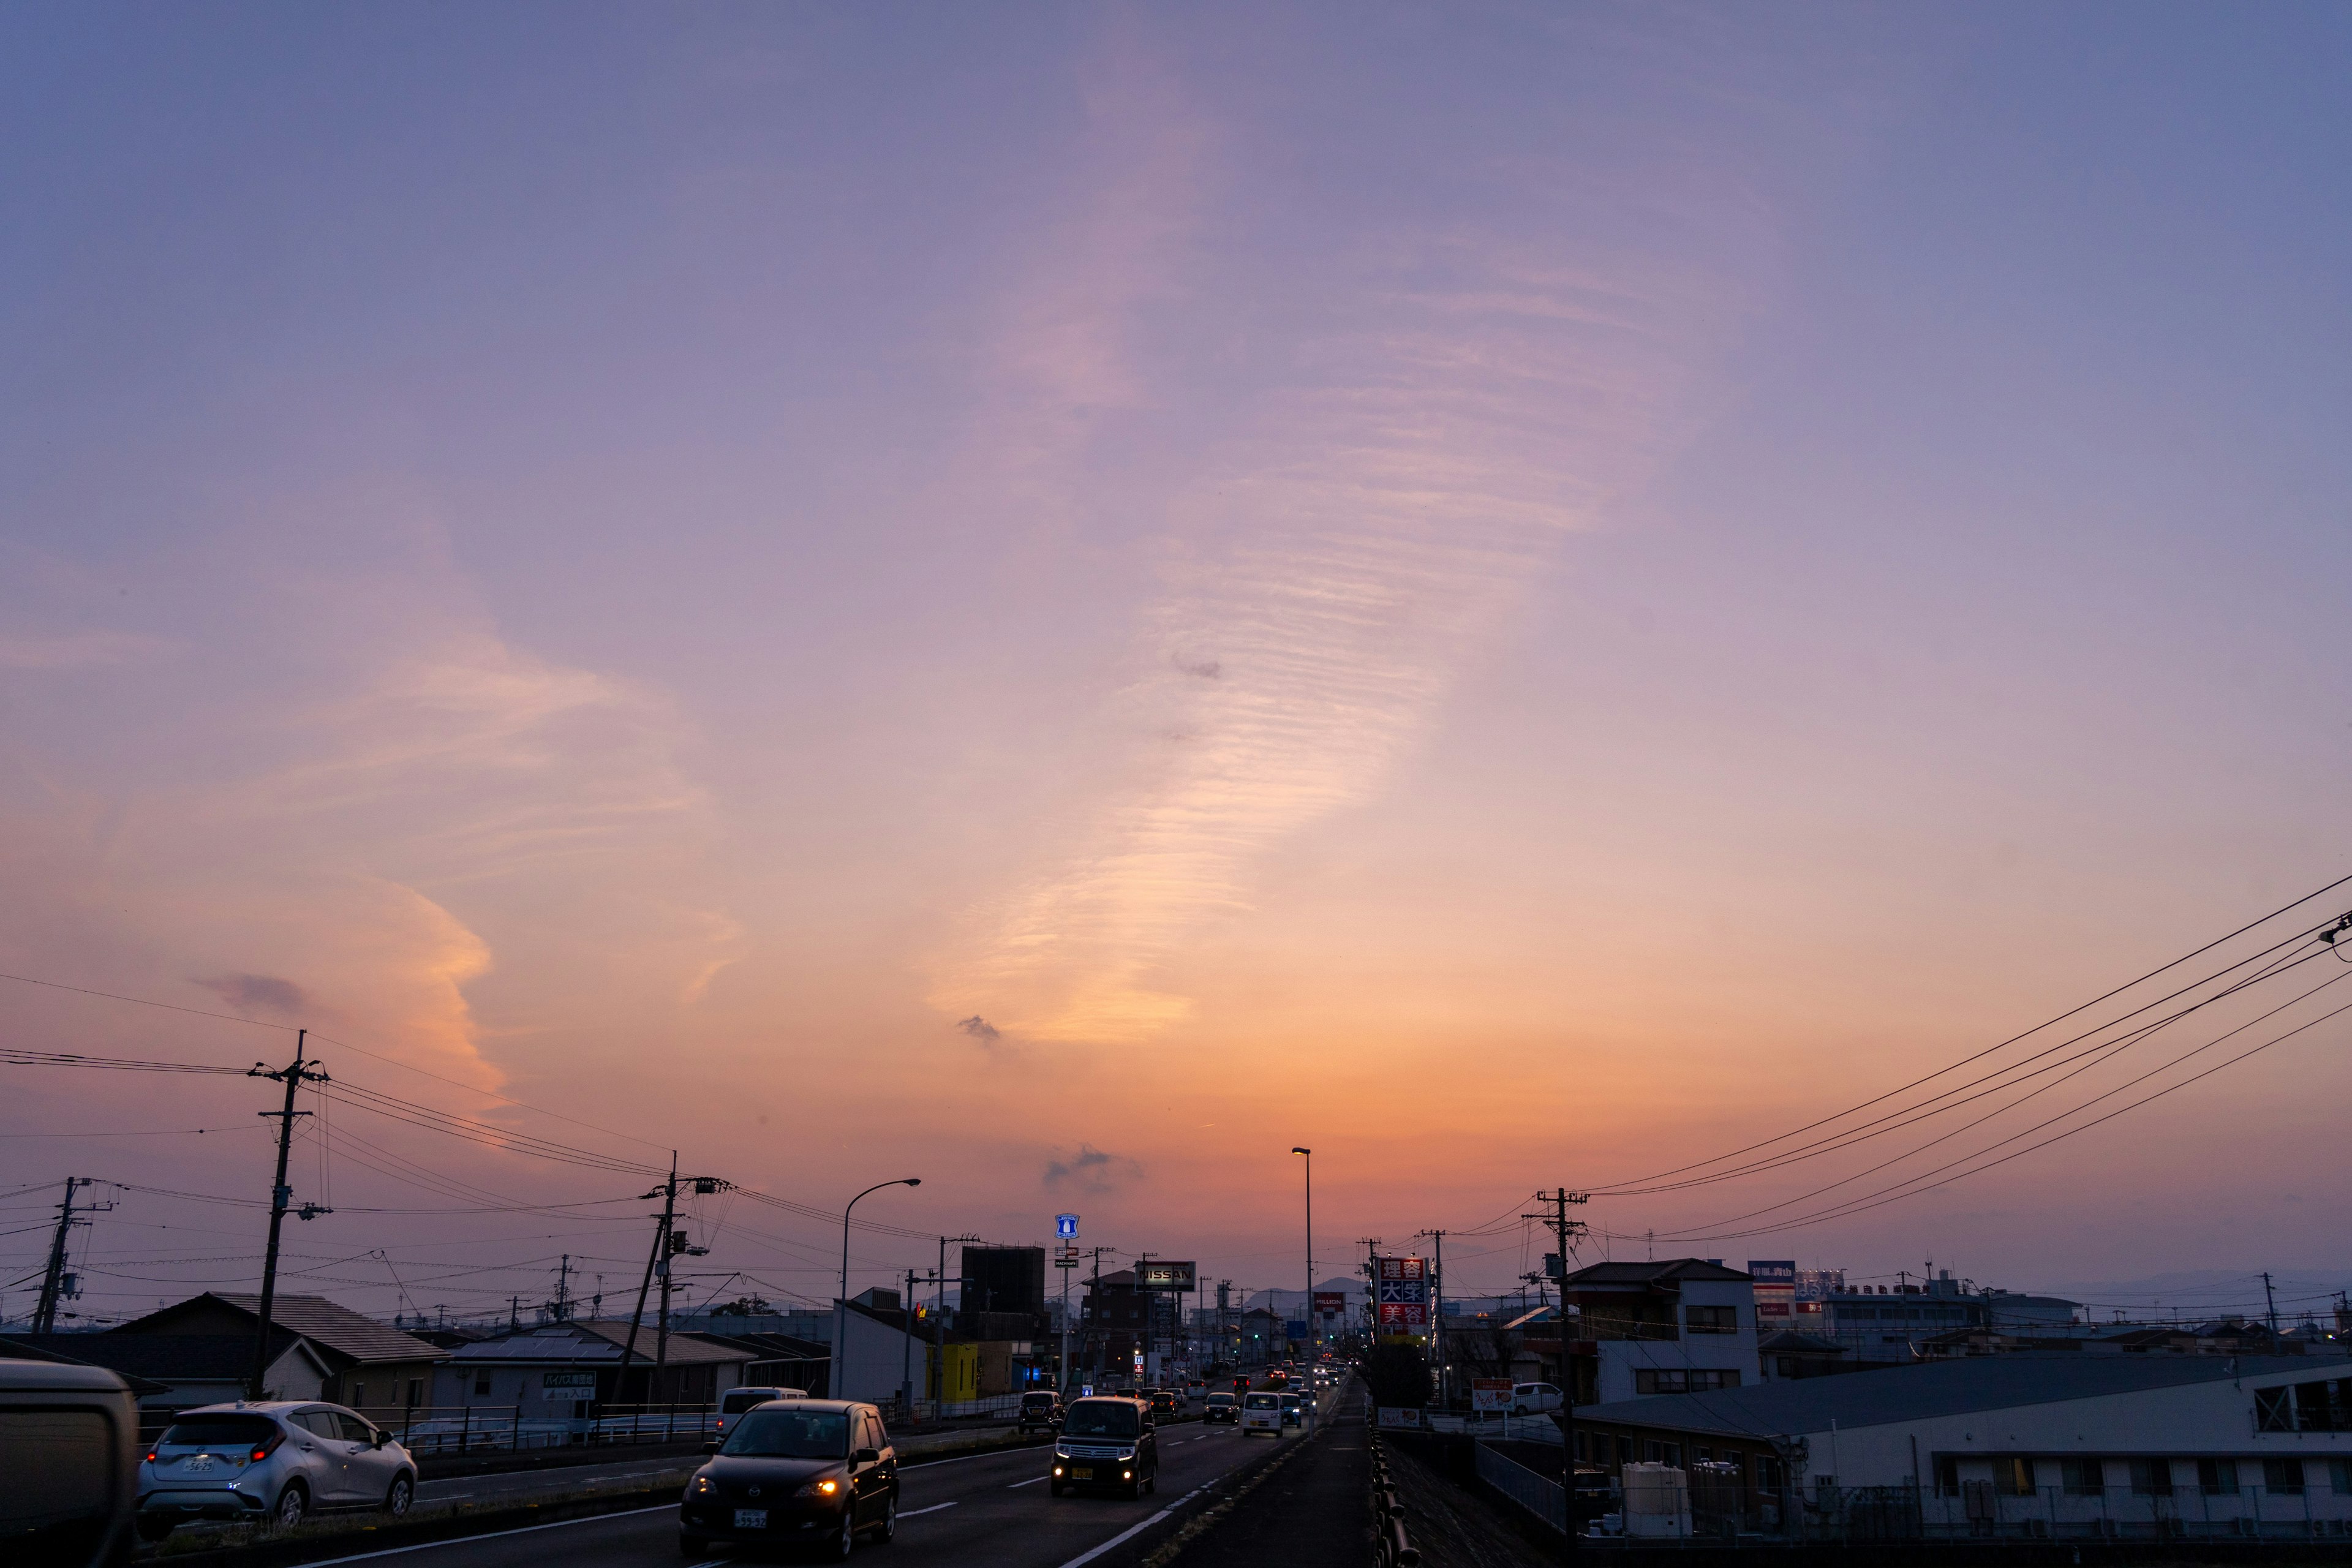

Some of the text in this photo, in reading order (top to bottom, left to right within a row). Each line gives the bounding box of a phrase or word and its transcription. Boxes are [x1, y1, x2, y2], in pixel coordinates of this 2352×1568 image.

[1384, 1261, 1420, 1278] 理容
[1753, 1267, 1792, 1276] 洋服の青山
[1139, 1270, 1191, 1279] NISSAN
[1384, 1305, 1422, 1324] 美容
[545, 1374, 593, 1385] バイパス南団地
[570, 1389, 590, 1398] 入口
[741, 1517, 766, 1526] 99-92
